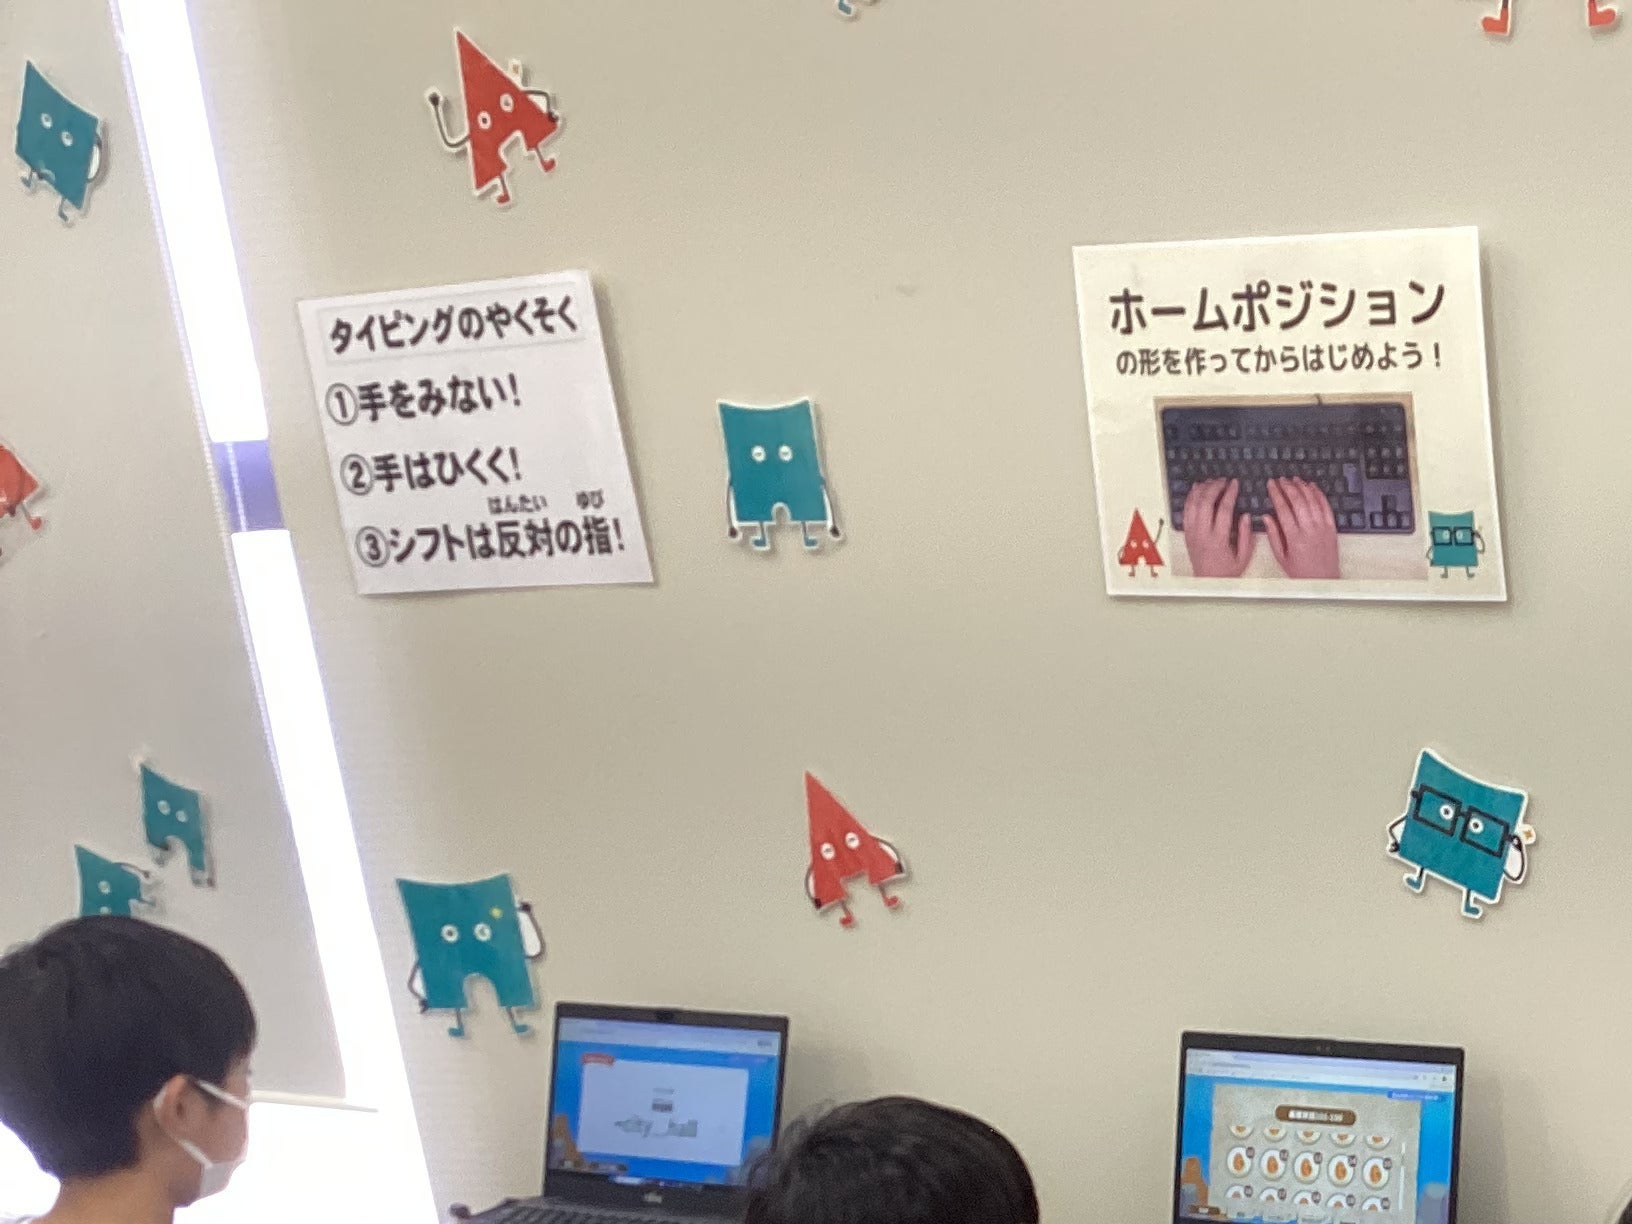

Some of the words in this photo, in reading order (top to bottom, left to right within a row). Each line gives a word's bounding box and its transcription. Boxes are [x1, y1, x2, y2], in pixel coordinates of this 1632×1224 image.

[329, 294, 579, 355] タイピングのやくそく
[1108, 278, 1446, 334] ホームポジション
[1115, 341, 1443, 376] の形を作ってからはじめよう！
[486, 494, 548, 515] はんたい
